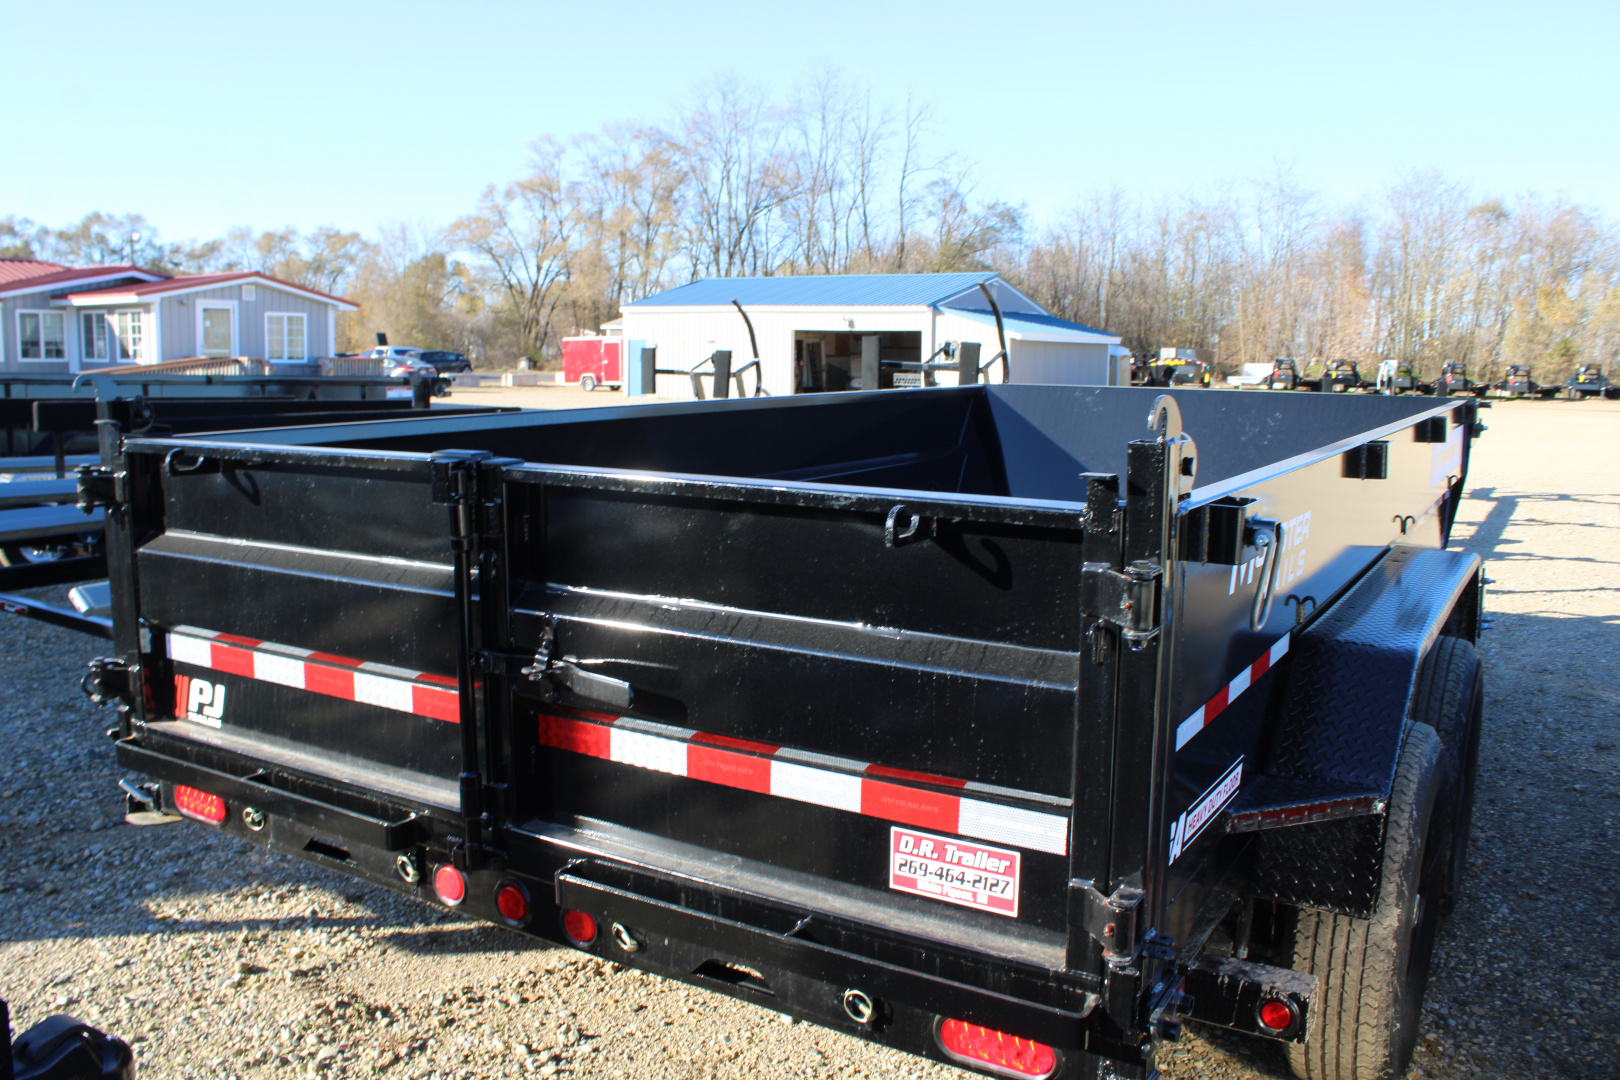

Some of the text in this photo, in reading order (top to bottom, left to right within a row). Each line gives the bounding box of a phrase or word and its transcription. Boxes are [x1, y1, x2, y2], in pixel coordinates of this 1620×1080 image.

[187, 678, 226, 718] PJ
[1187, 802, 1208, 834] HEAVY
[1207, 790, 1223, 814] DUTY
[1222, 771, 1240, 800] FLOOR
[898, 834, 1011, 874] D.R. Trailer
[898, 857, 1011, 895] 269-464-2127
